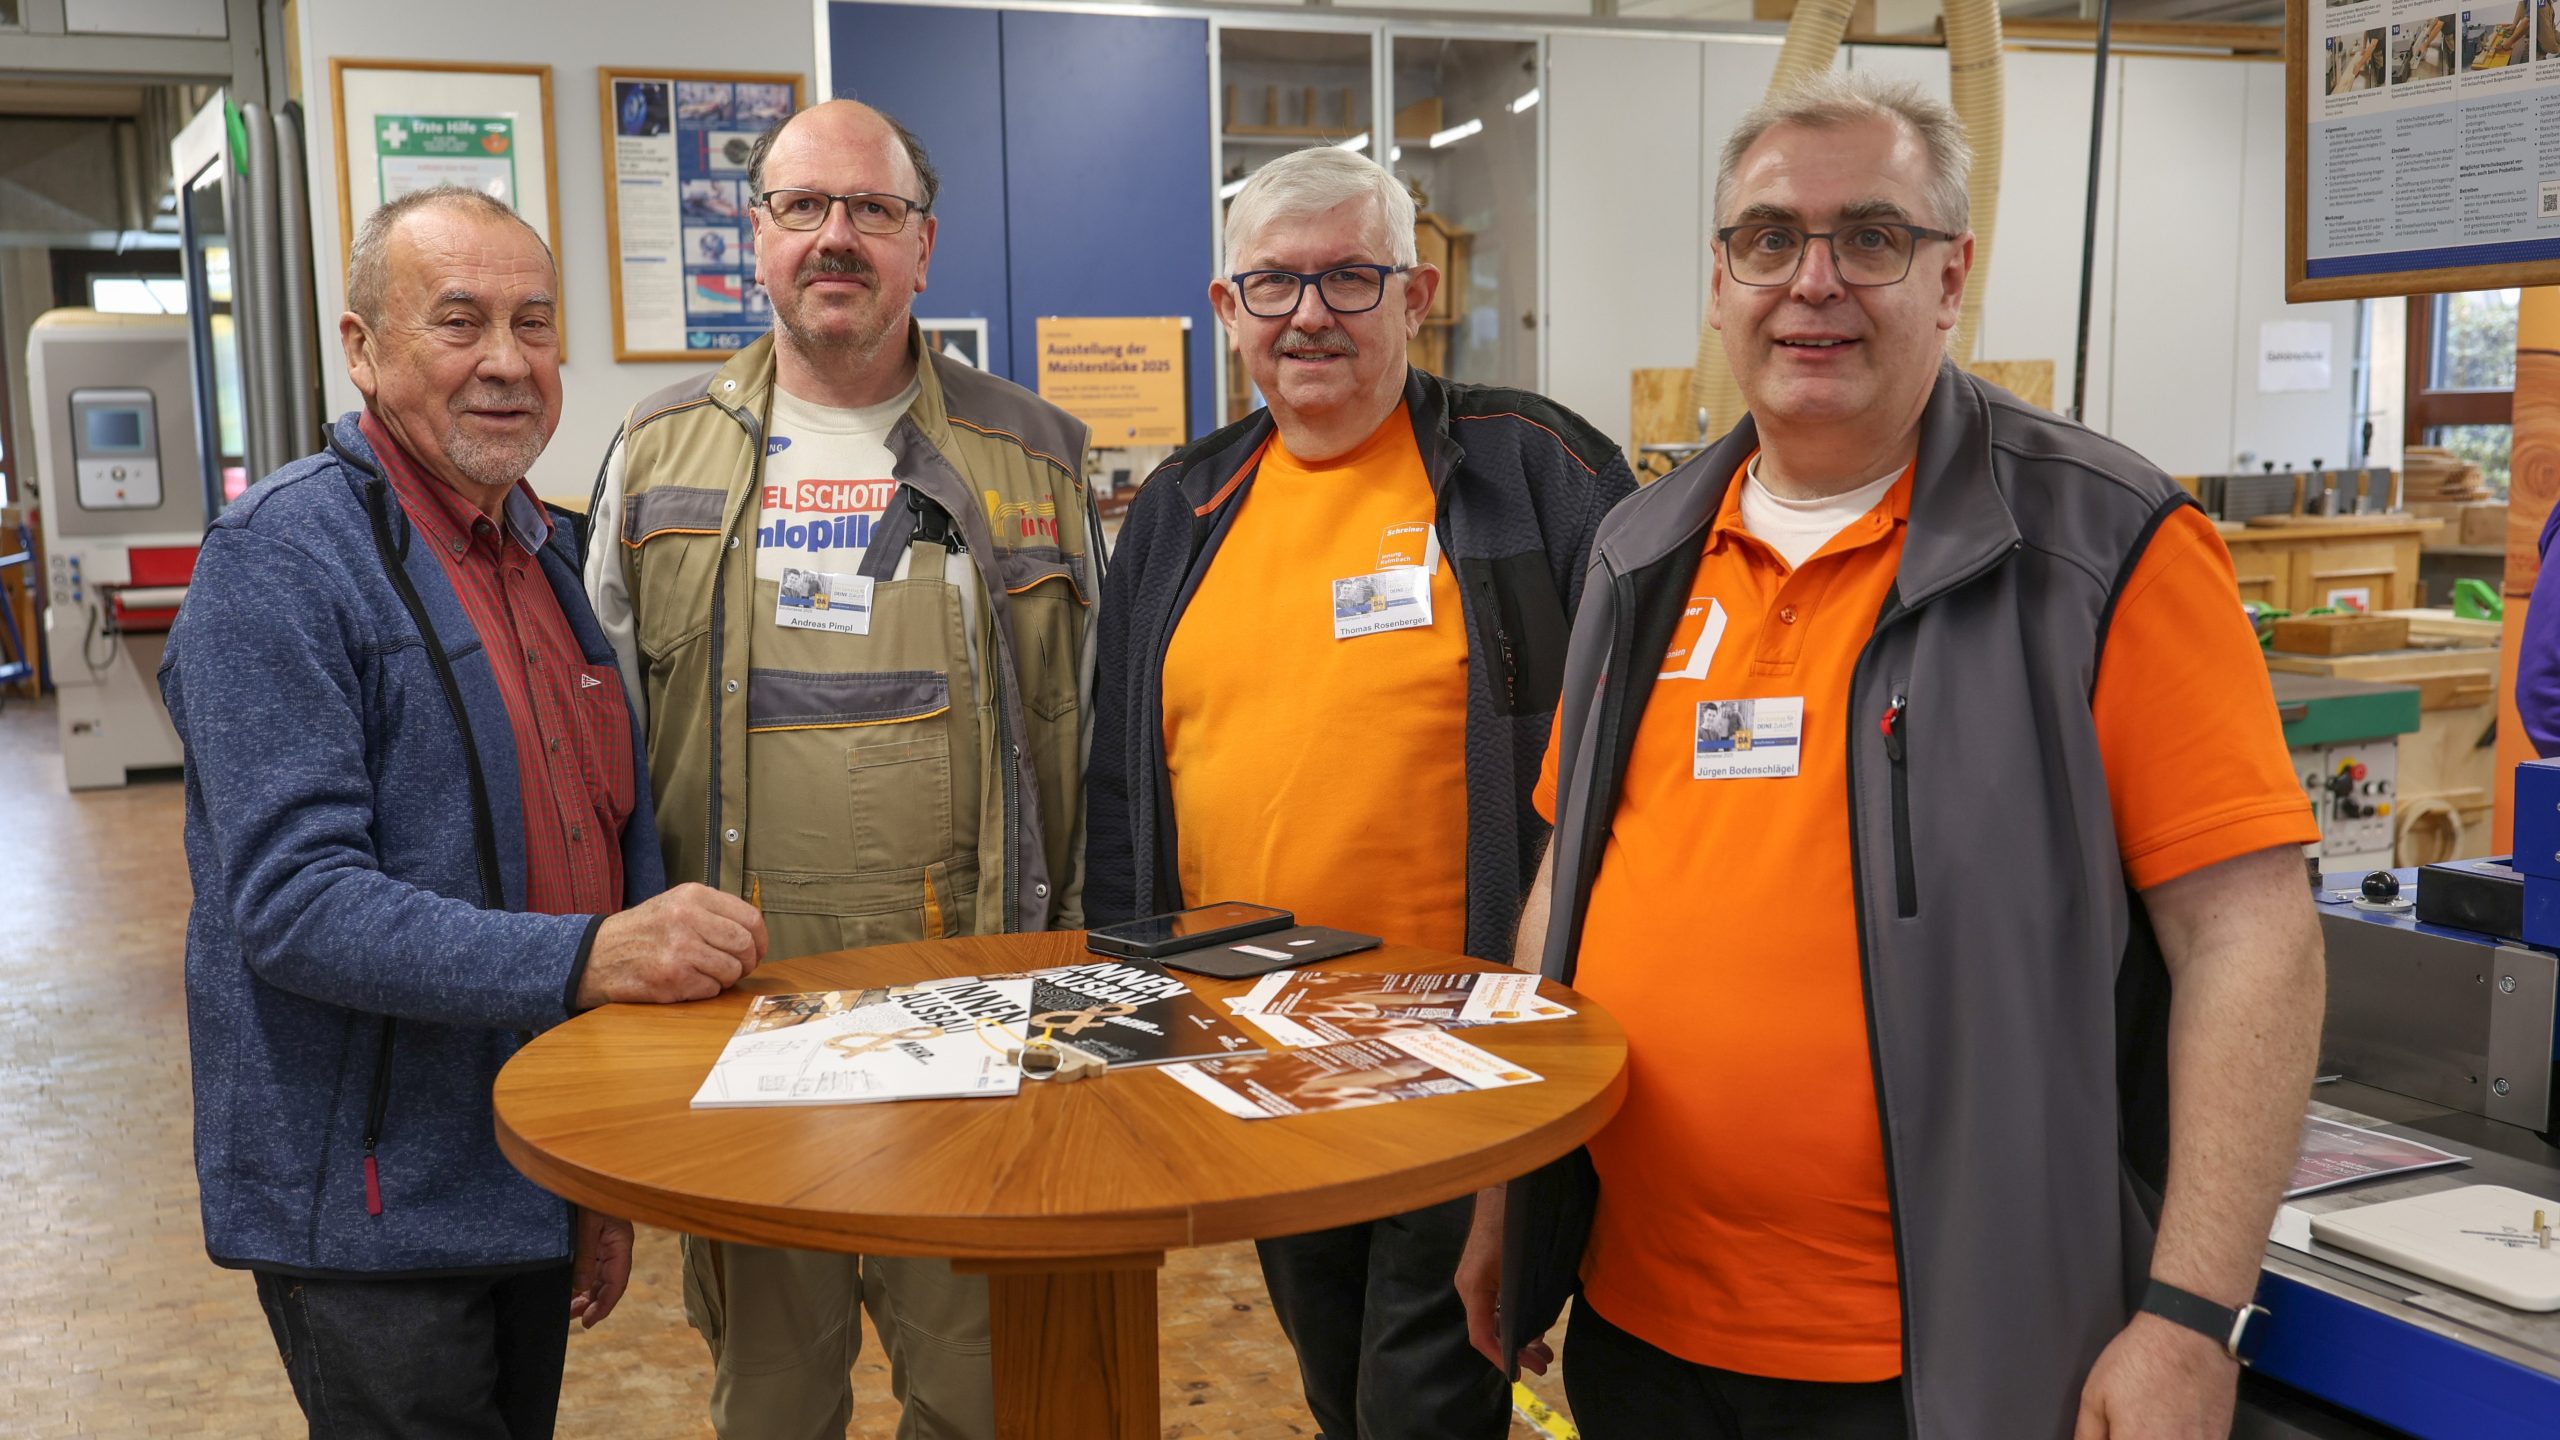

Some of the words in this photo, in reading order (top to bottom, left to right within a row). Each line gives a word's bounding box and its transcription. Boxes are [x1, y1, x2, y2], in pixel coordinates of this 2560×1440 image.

[1047, 342, 1123, 358] Ausstellung
[1126, 342, 1146, 354] der
[1048, 360, 1138, 373] Meisterstücke
[769, 443, 783, 452] NG
[756, 514, 881, 552] nlopill
[1386, 526, 1424, 536] Schreiner
[790, 618, 826, 629] Andreas
[828, 622, 854, 632] Pimpl
[1340, 624, 1372, 636] Thomas
[1374, 616, 1426, 630] Rosenberger
[1697, 768, 1727, 778] Jürgen
[1729, 764, 1794, 776] Bodenschlägel
[1033, 972, 1160, 1006] AUSBAU
[1070, 962, 1192, 1000] INNEN
[888, 992, 980, 1034] AUSBAU
[936, 981, 1029, 1028] INNEN
